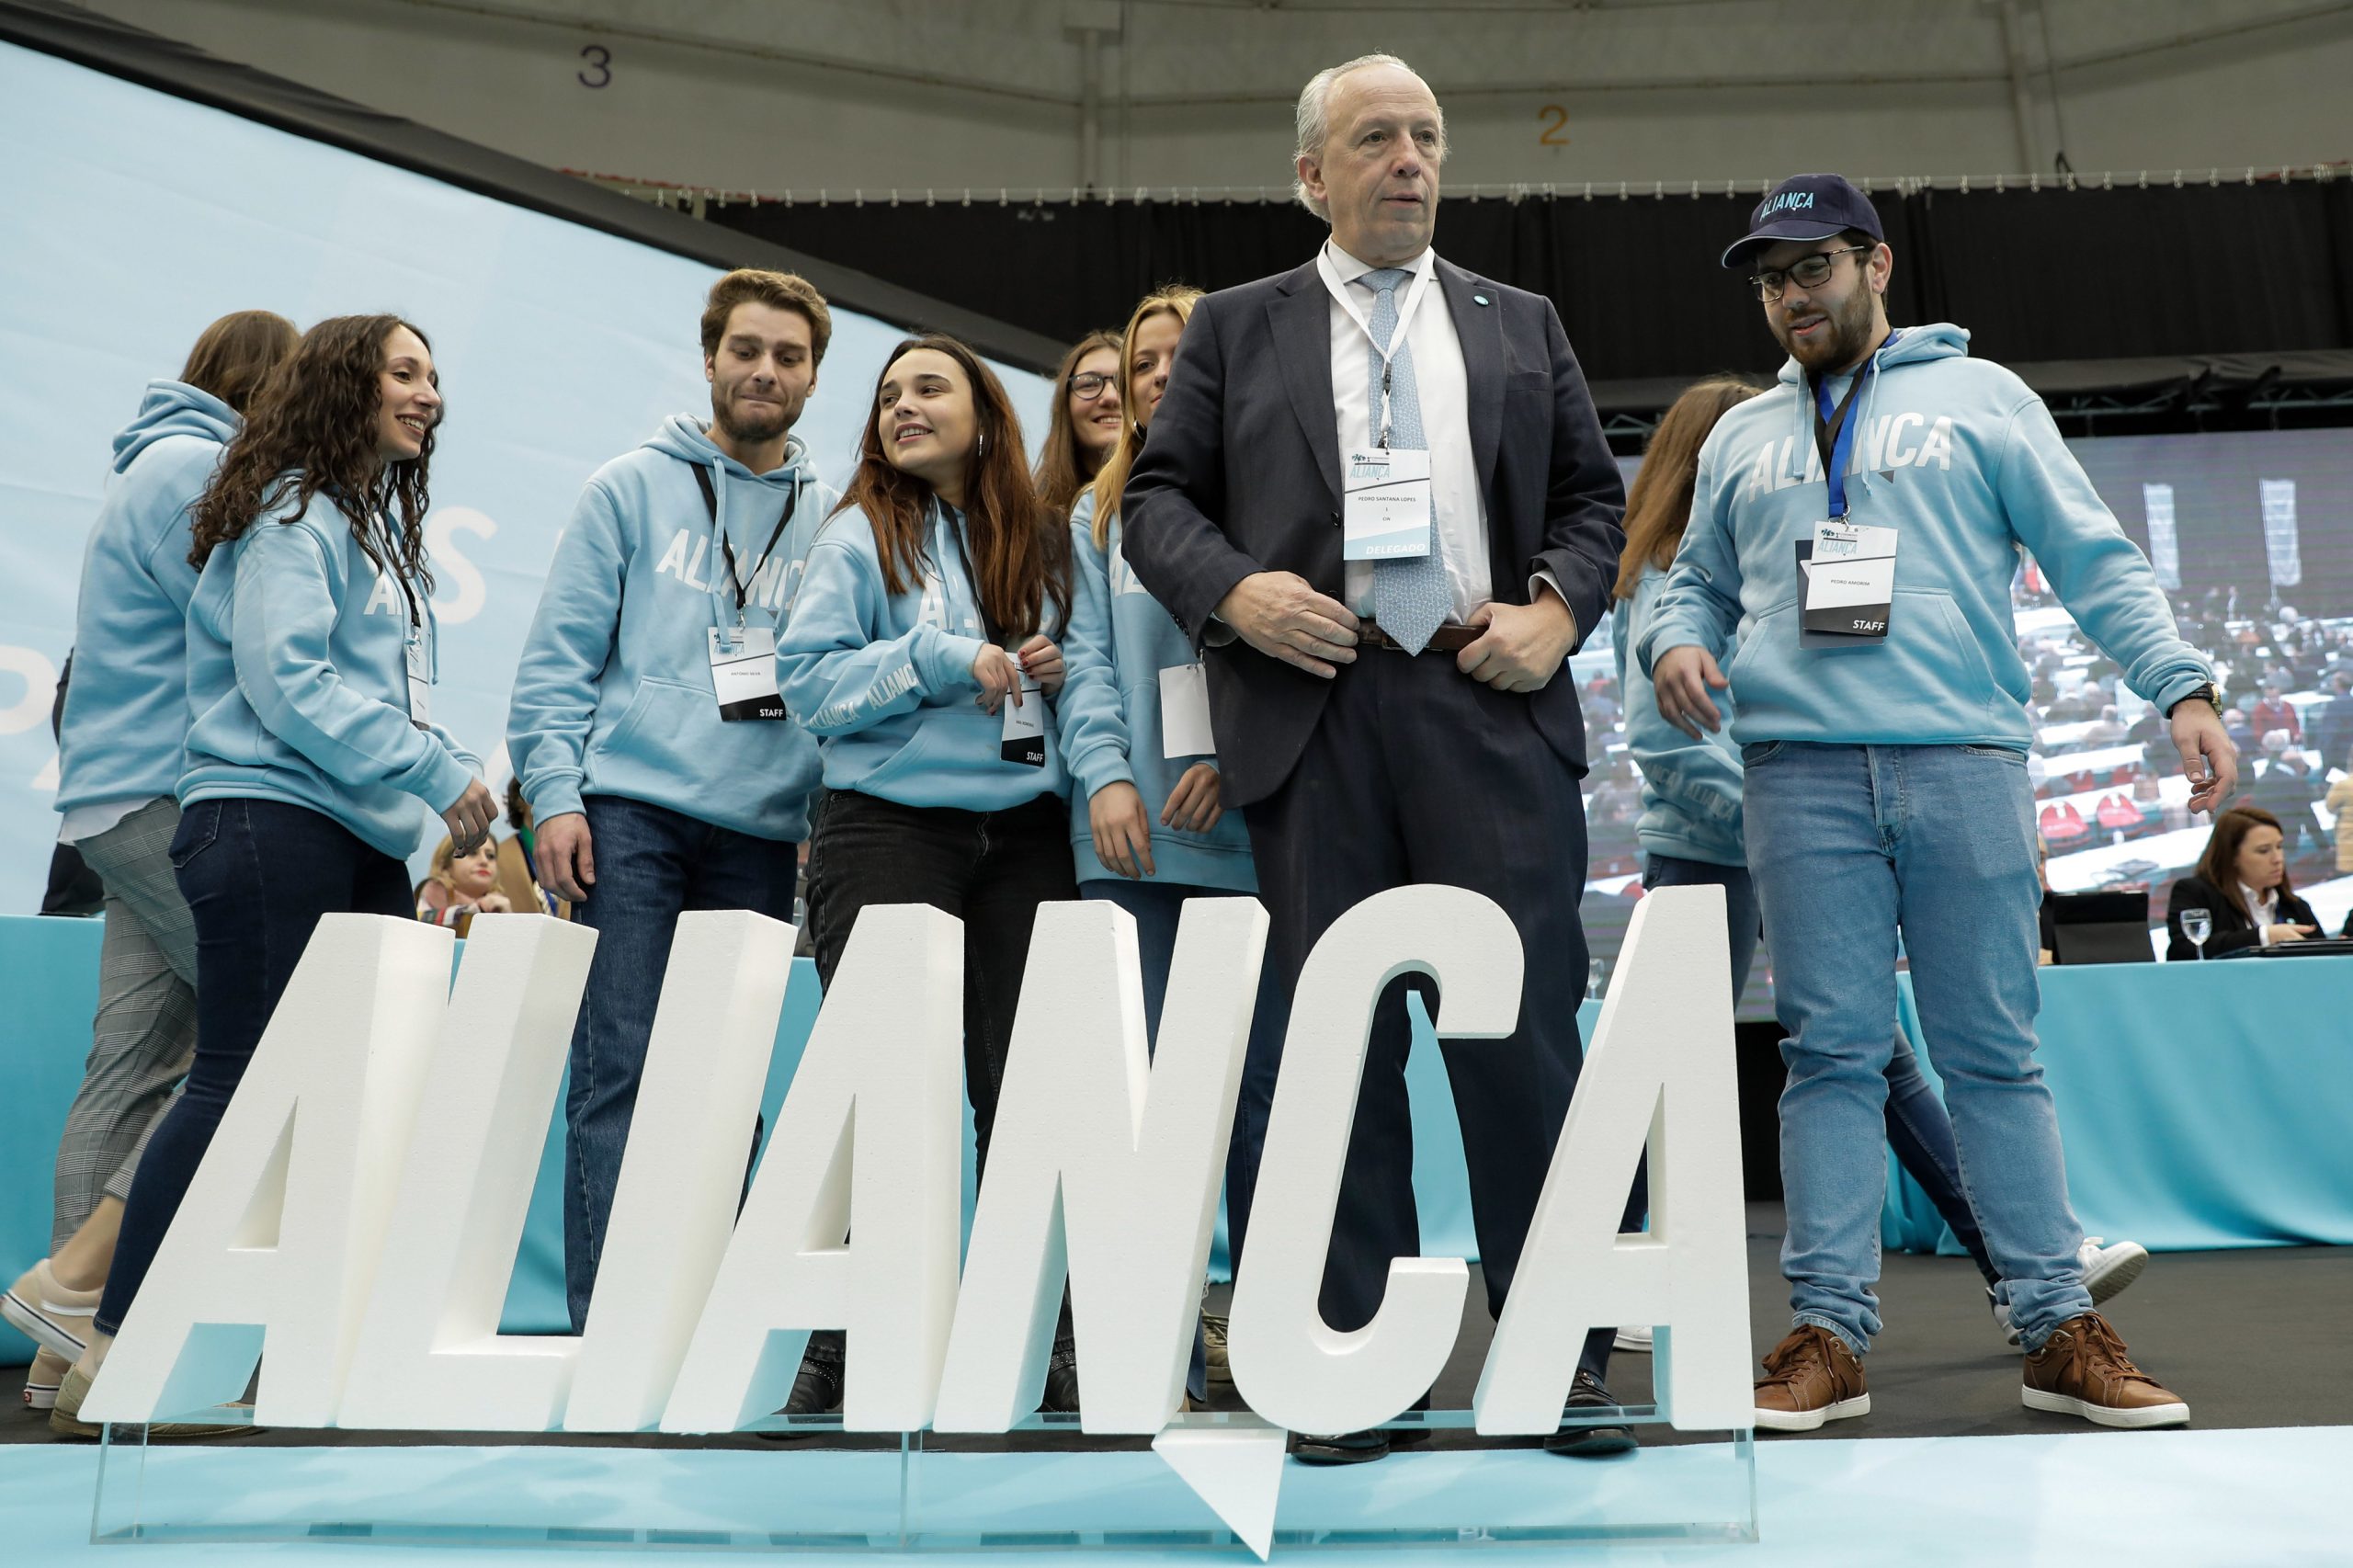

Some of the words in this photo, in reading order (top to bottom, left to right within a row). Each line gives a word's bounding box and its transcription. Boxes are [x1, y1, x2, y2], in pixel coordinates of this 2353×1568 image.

[577, 44, 612, 89] 3
[1539, 105, 1570, 146] 2
[1366, 543, 1426, 555] DELEGADO
[1852, 619, 1885, 631] STAFF
[759, 708, 784, 717] STAFF
[1026, 751, 1044, 763] STAFF
